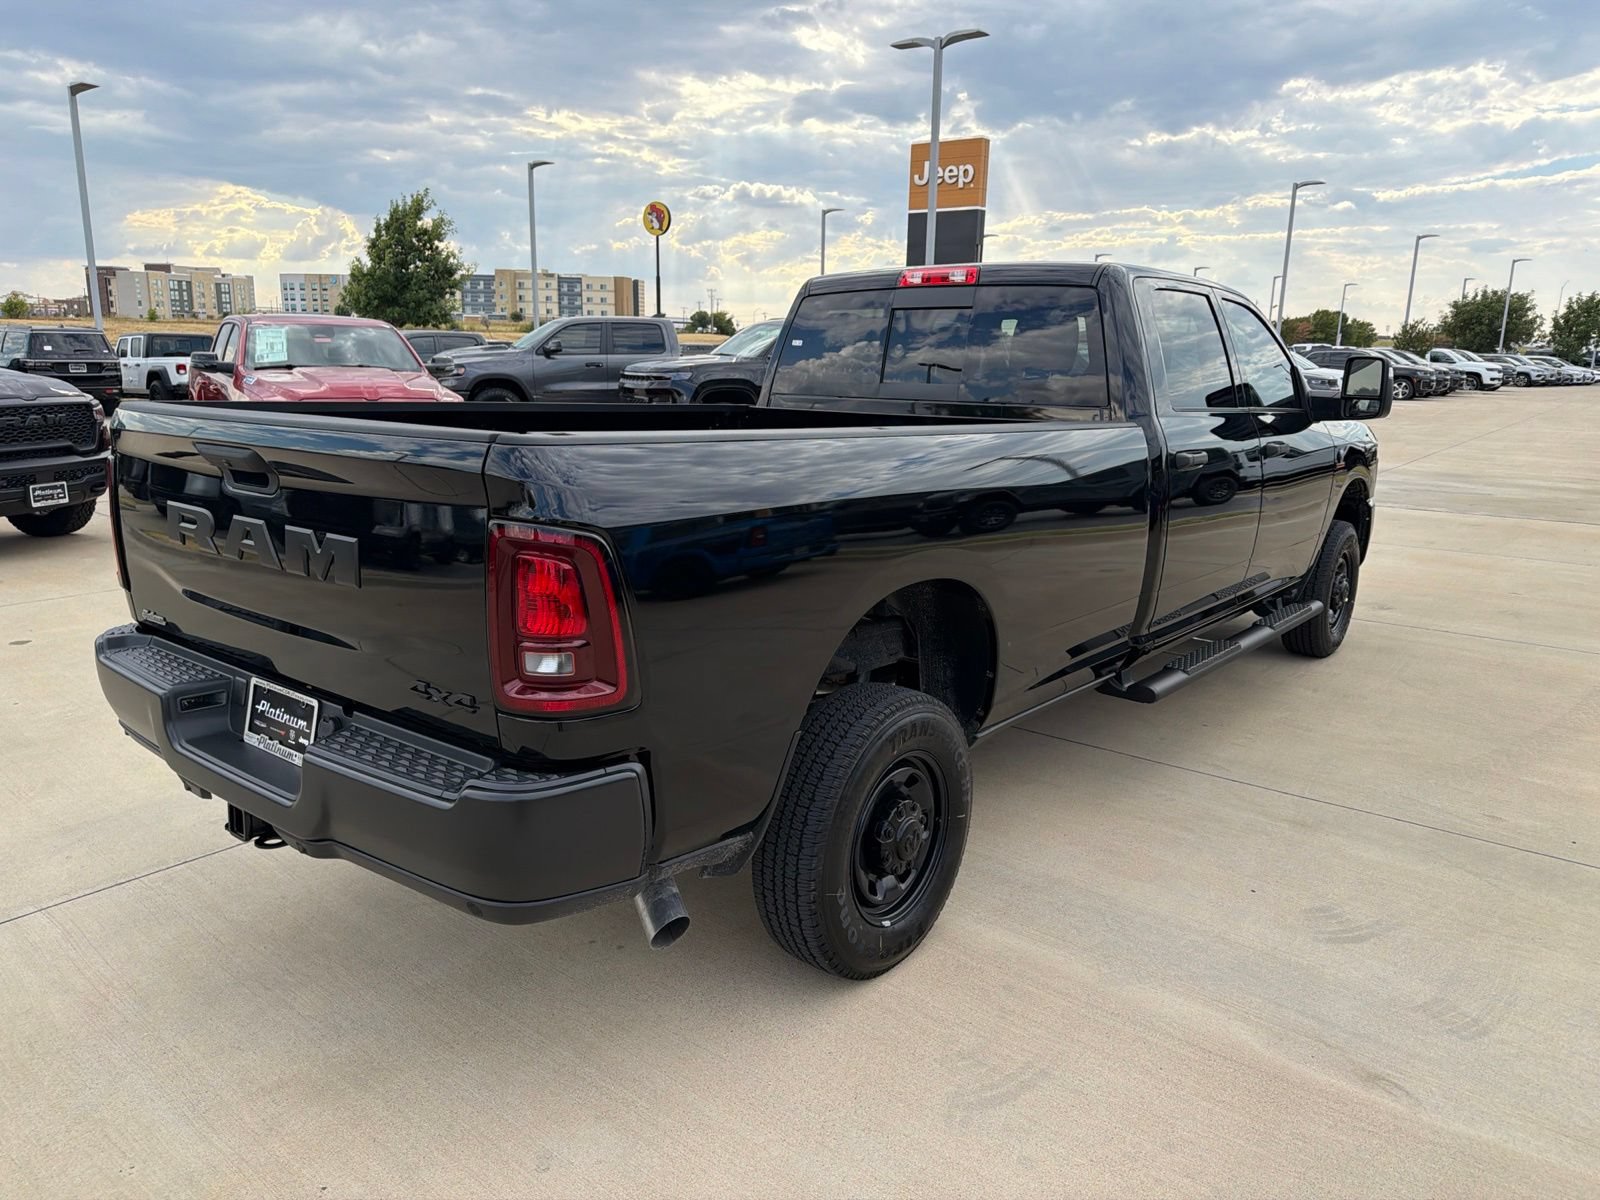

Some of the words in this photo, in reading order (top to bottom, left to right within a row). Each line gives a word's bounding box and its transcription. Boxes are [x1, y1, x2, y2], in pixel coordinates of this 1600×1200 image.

[166, 500, 361, 588] RAM
[255, 699, 310, 733] Platinum
[257, 735, 297, 763] Platinum
